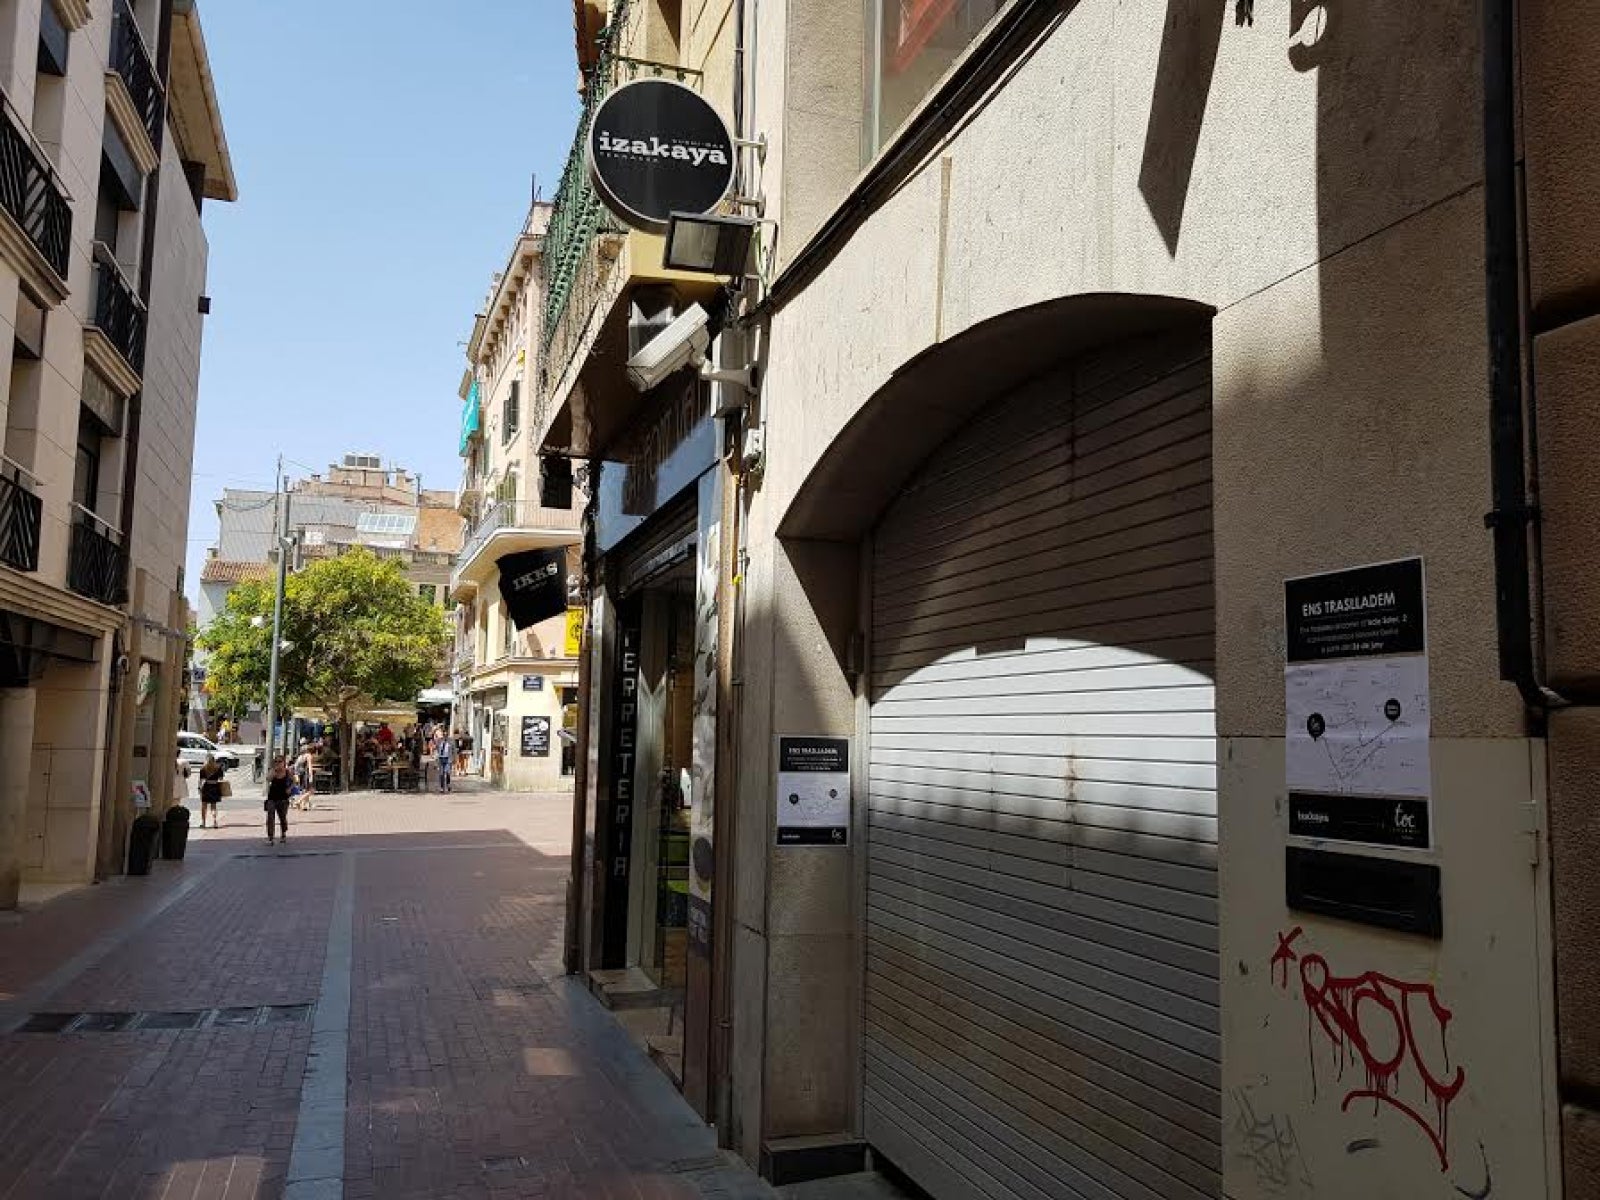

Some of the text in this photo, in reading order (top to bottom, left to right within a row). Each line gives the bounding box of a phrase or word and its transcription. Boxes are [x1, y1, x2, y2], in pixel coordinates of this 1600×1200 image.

[599, 131, 728, 167] izakaya
[1301, 591, 1396, 617] ENS TRASLLADEM
